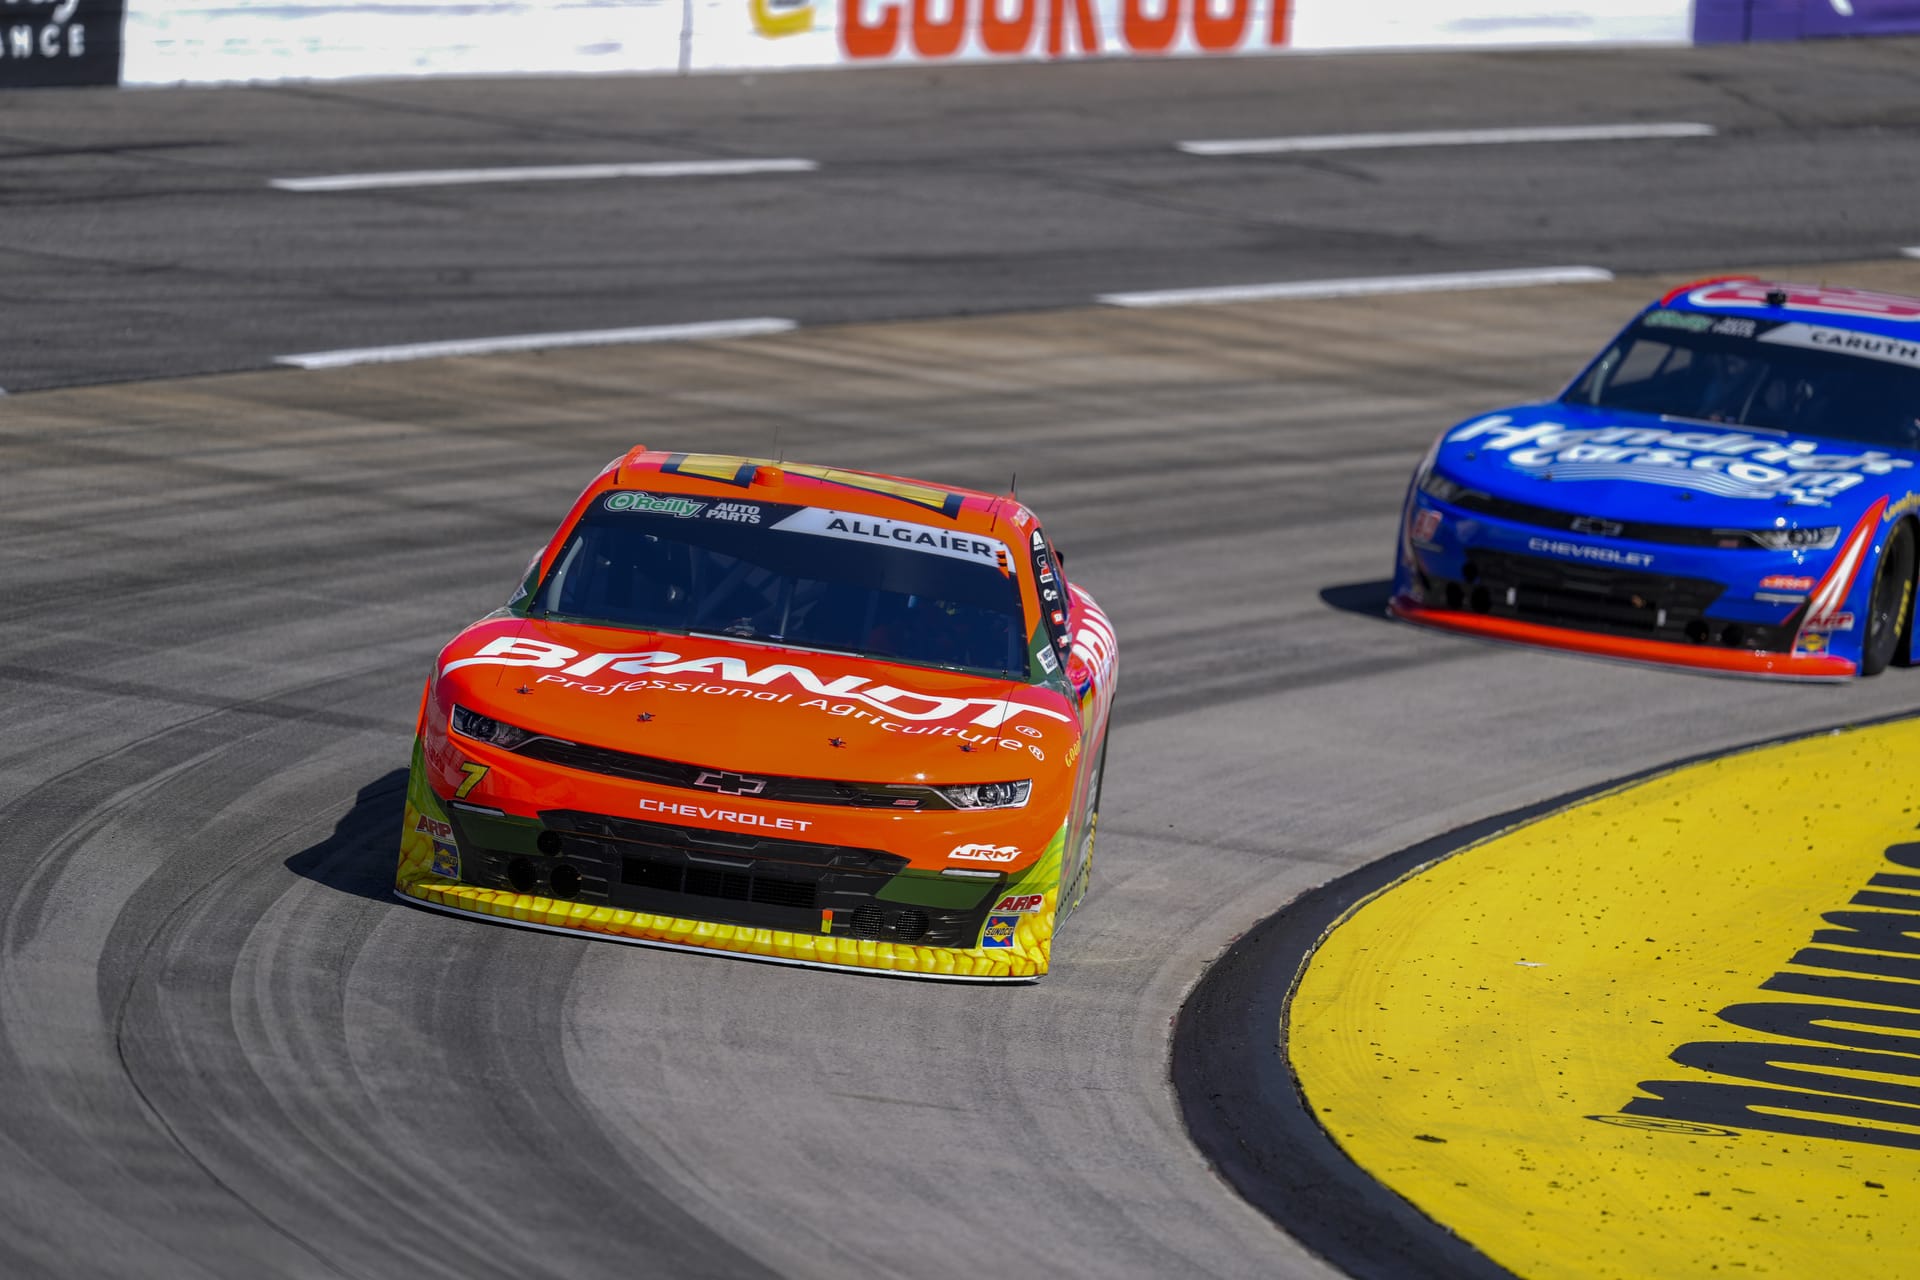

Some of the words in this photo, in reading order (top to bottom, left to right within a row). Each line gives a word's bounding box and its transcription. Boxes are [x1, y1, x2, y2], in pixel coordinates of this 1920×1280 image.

[1811, 331, 1918, 359] CARUTH
[1448, 414, 1914, 475] Hendrick
[609, 492, 702, 516] O'Reilly
[705, 508, 761, 524] PARTS
[714, 502, 761, 515] AUTO
[825, 517, 993, 558] ALLGAIER
[1529, 536, 1655, 568] CHEVROLET
[441, 636, 1072, 729] BRANDT
[536, 674, 793, 703] Professional
[455, 761, 490, 800] 7
[415, 815, 453, 838] ARP
[639, 798, 812, 832] CHEVROLET
[954, 848, 1014, 861] JRM
[993, 894, 1043, 911] ARP
